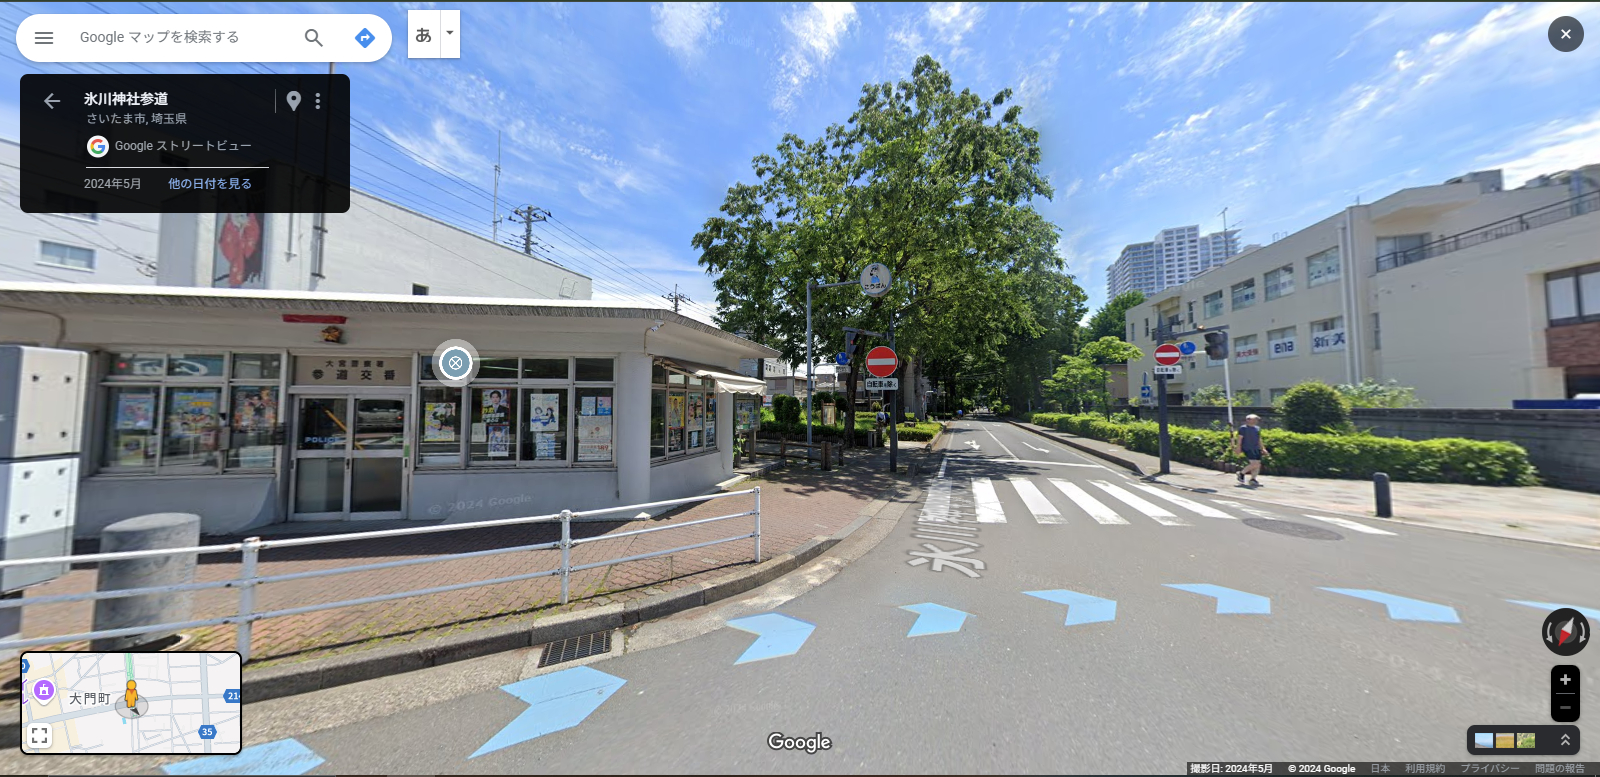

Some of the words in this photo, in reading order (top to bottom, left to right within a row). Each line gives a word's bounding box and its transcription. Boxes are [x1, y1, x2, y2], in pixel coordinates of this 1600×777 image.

[1274, 340, 1294, 354] ena
[325, 359, 384, 368] 大宮警察署
[312, 369, 395, 380] 参道交番
